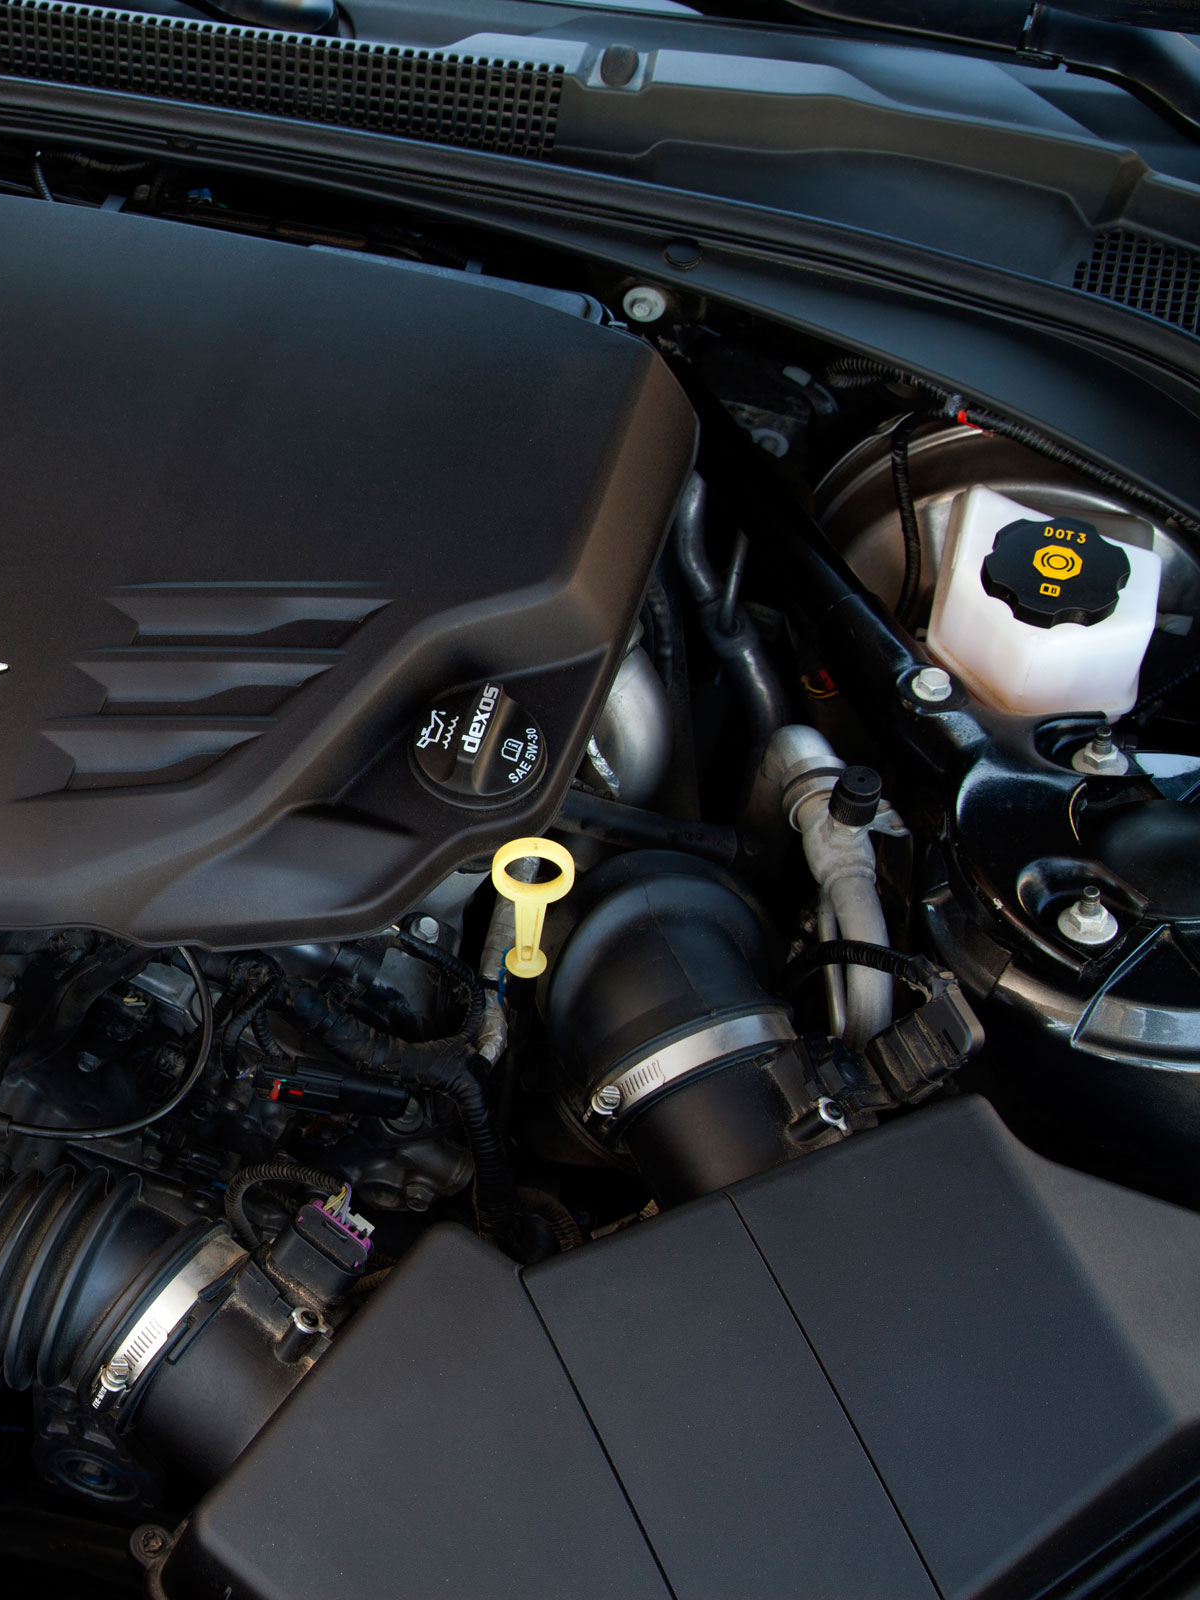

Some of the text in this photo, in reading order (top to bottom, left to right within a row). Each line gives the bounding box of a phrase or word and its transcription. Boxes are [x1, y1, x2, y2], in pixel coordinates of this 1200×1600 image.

[1044, 526, 1087, 544] DOT 3
[462, 683, 499, 753] dexos
[508, 727, 540, 783] SAE 5W-30
